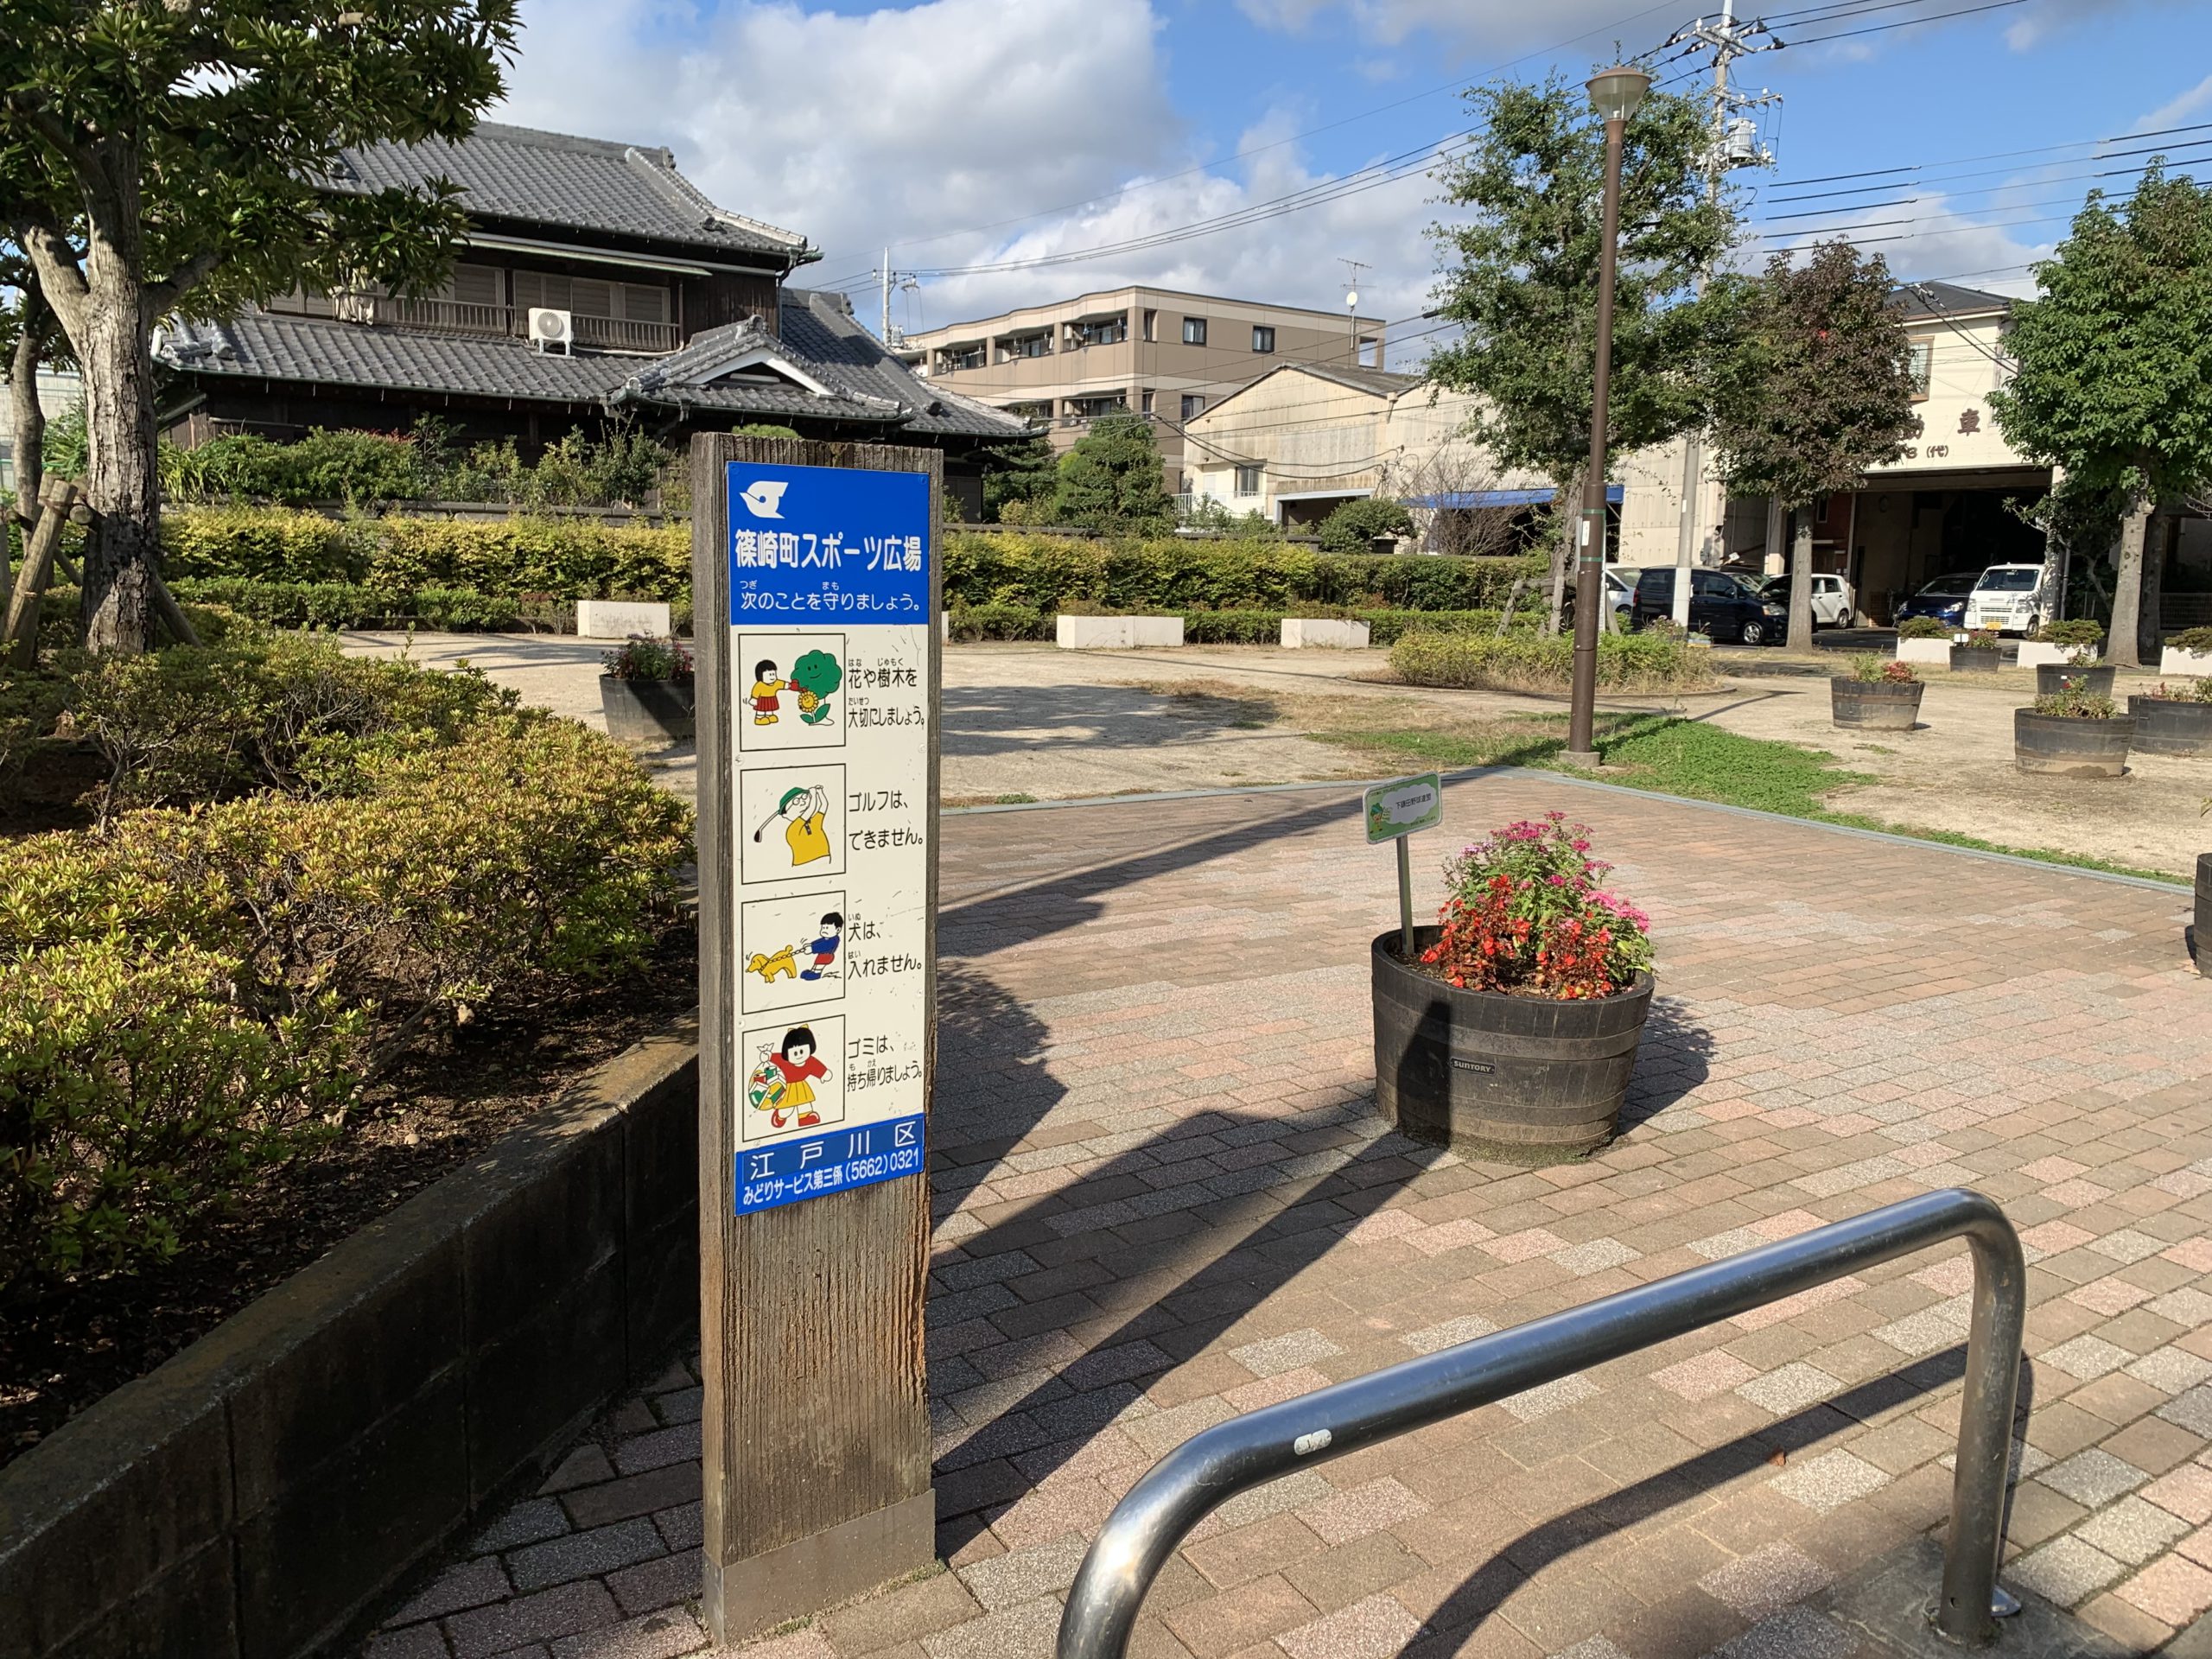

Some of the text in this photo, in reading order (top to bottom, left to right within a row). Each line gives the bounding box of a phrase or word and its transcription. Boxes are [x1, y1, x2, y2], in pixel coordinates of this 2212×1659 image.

[735, 528, 922, 571] 篠崎町スポーツ広場
[740, 580, 840, 590] つぎ まも
[741, 591, 919, 611] 次のことを守りましょう。
[848, 658, 904, 667] はな じゅもく
[848, 667, 918, 689] 花や樹木を
[848, 696, 870, 705] たいせつ
[848, 705, 925, 728] 大切にしましょう。
[849, 790, 908, 812] ゴルフは、
[849, 827, 924, 850] できません。
[848, 912, 861, 921] いぬ
[848, 921, 881, 942] 犬は、
[848, 953, 922, 980] 入れません。
[848, 1034, 894, 1059] ゴミは、
[847, 1060, 923, 1092] 持ち帰りましょう。
[750, 1121, 917, 1181] 江戸川区
